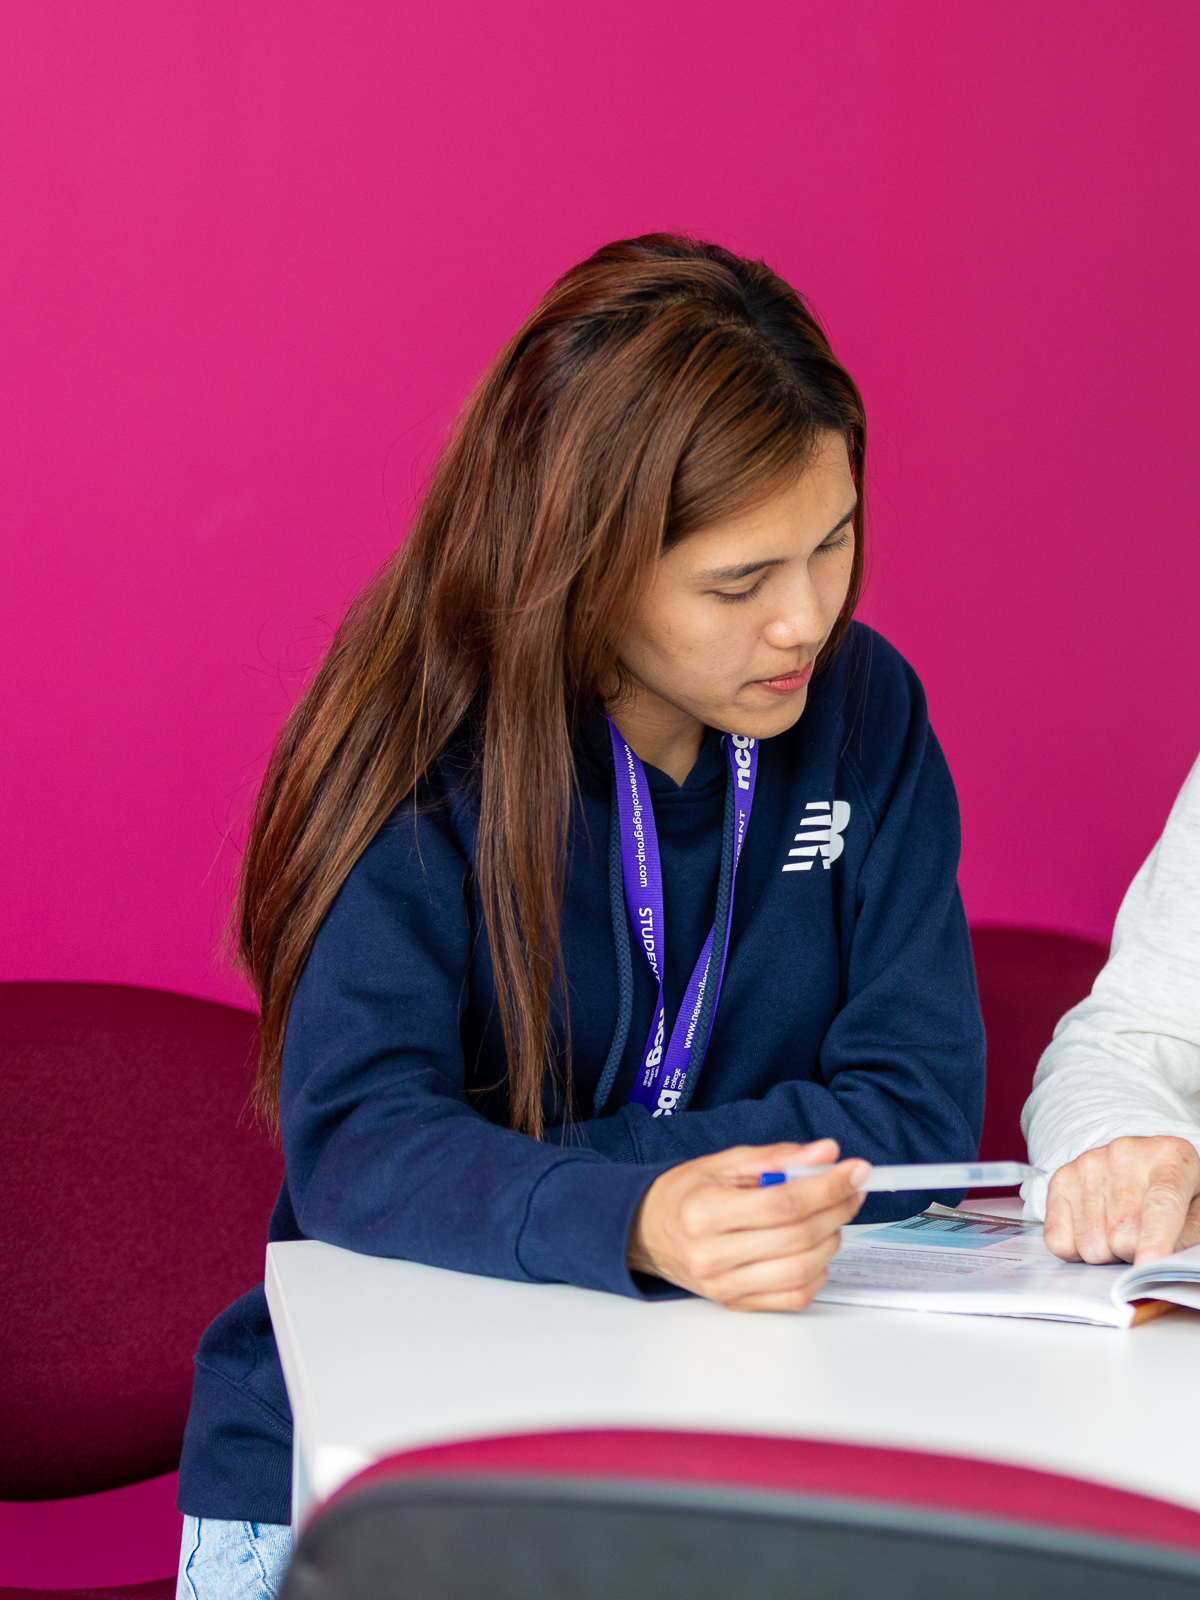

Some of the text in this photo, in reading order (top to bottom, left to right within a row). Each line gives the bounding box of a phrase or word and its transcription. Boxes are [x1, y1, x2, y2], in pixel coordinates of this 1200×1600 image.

[624, 744, 648, 888] www.newcollegegroup.com
[638, 907, 661, 983] STUDENT
[663, 1075, 671, 1088] new
[670, 1068, 681, 1089] college
